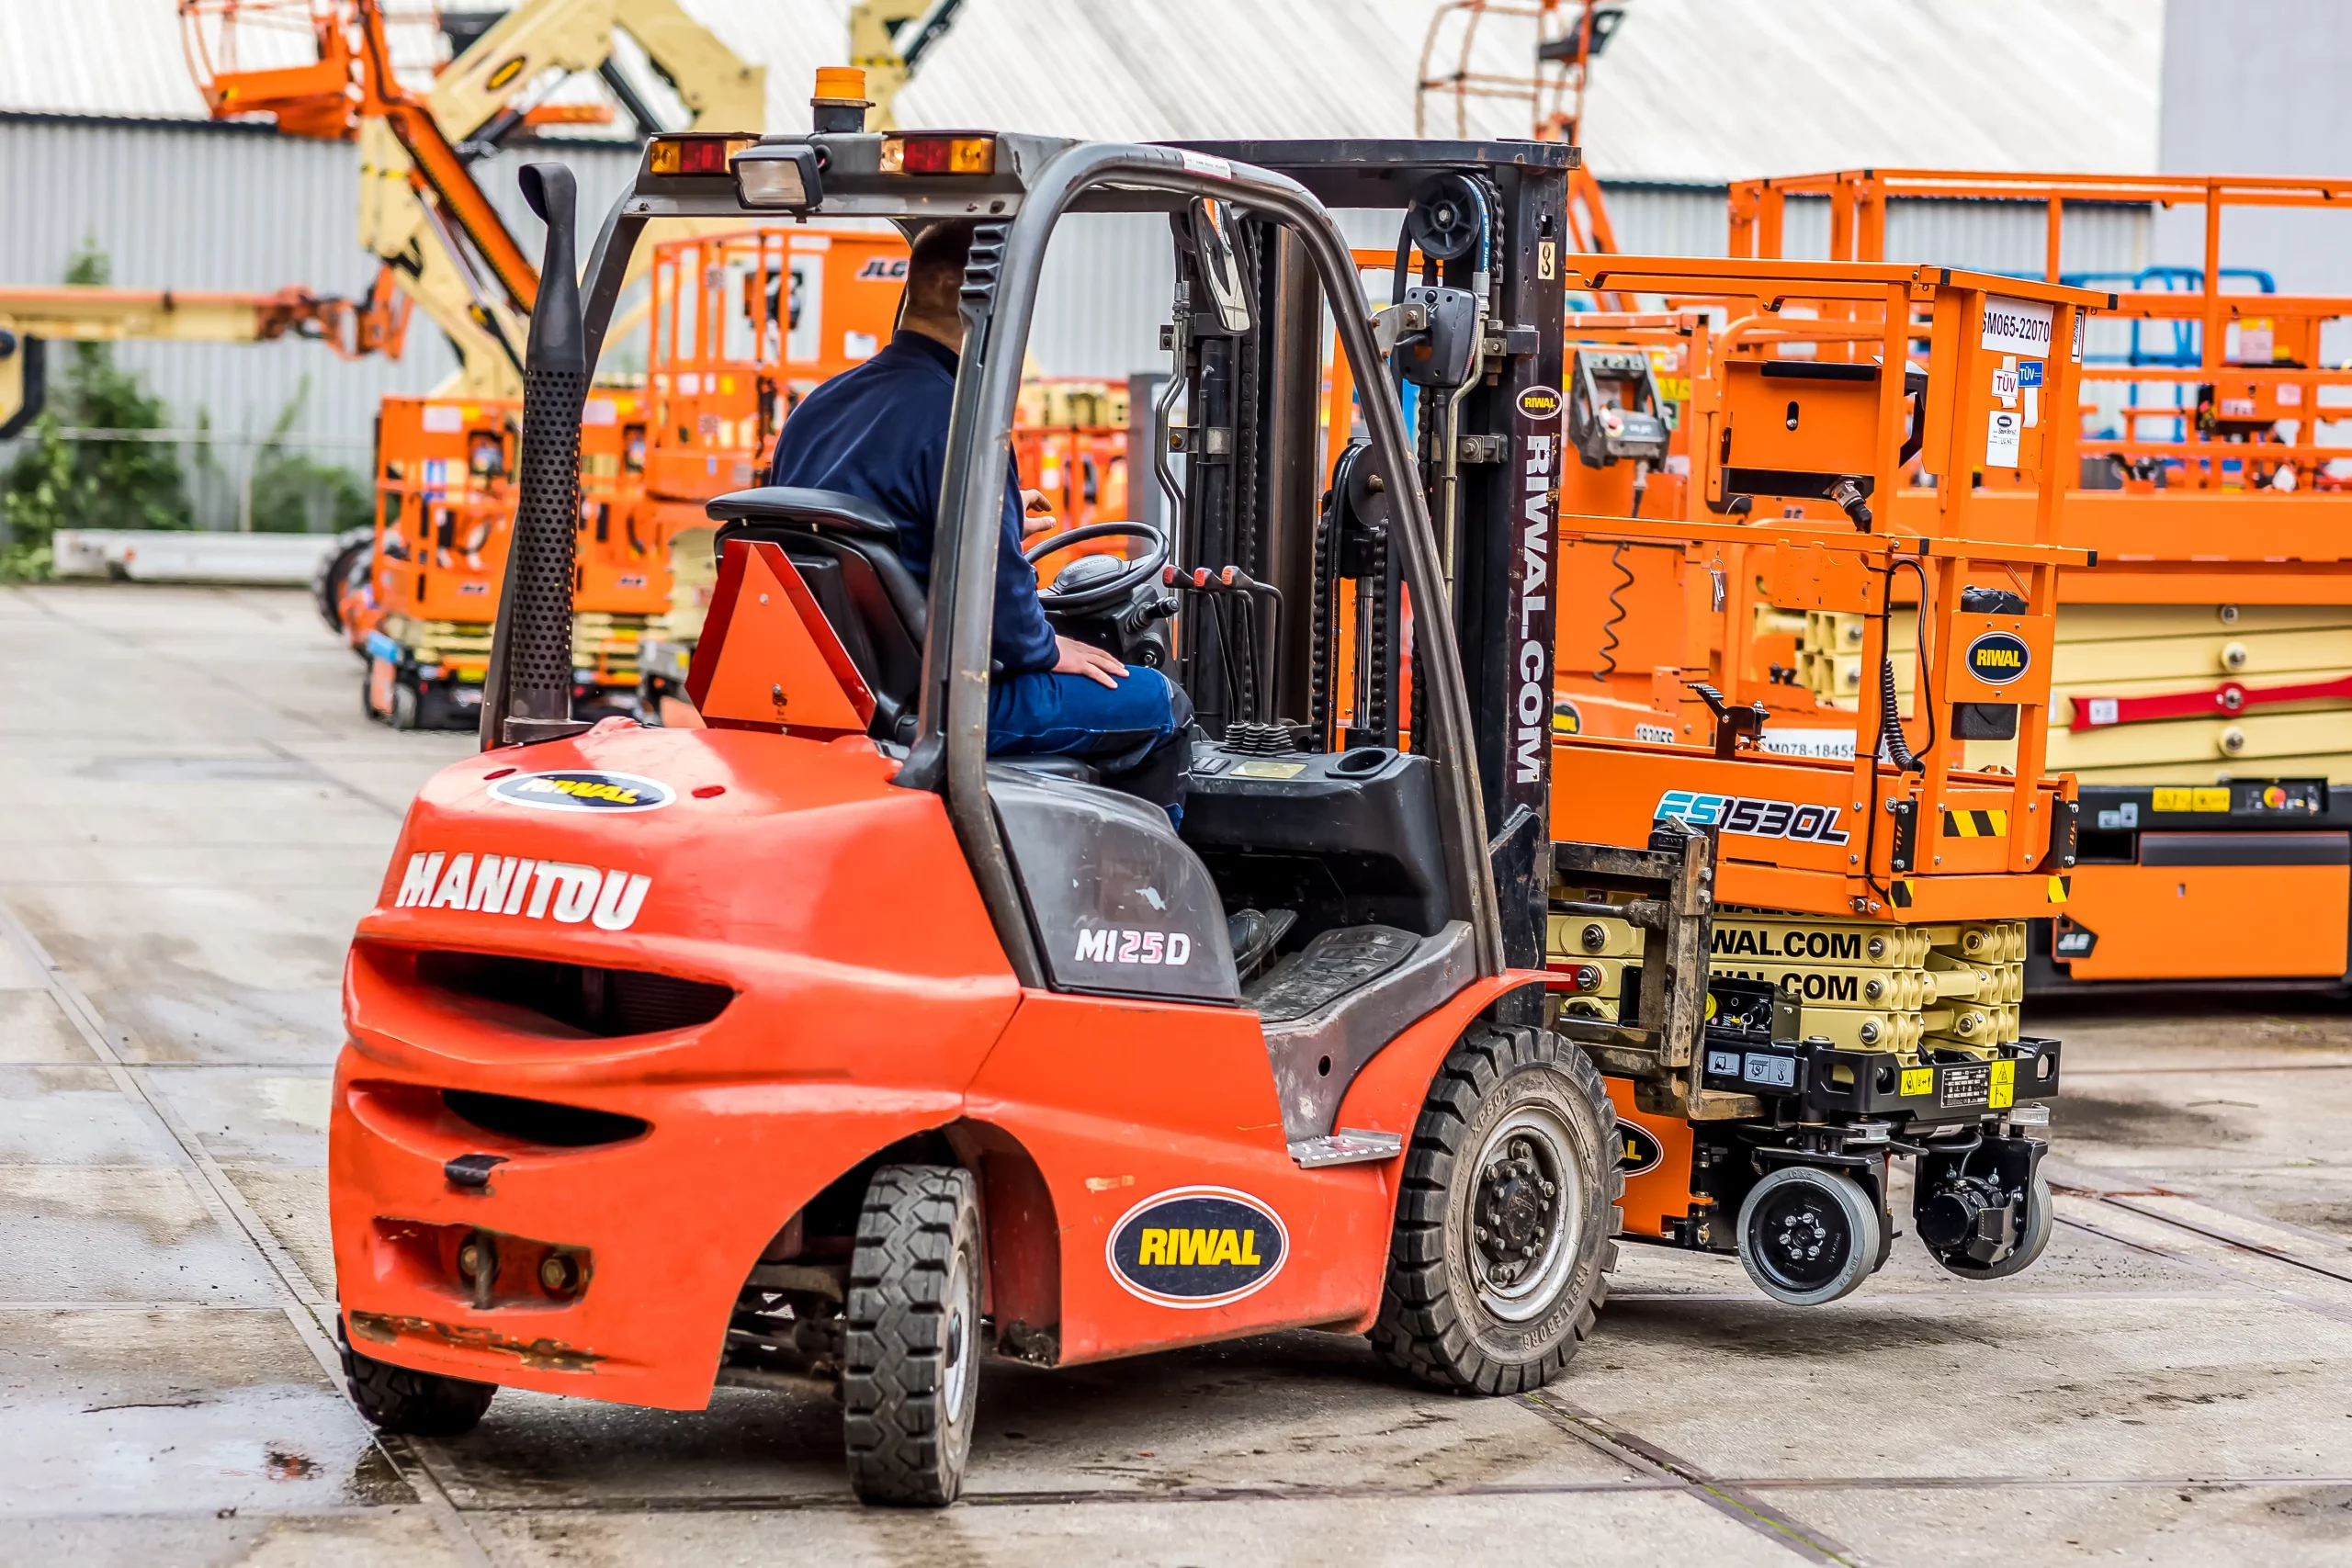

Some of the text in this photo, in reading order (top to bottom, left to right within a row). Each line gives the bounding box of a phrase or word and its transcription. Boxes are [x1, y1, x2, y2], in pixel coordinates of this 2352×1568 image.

[1996, 373, 2017, 393] TÜV
[2019, 367, 2035, 380] TÜV
[1524, 397, 1556, 409] RIWAL
[1515, 434, 1551, 784] RIWAL.COM
[1976, 649, 2021, 668] RIWAL
[1761, 742, 1855, 759] M078-18455
[516, 779, 641, 804] RIWAL
[1657, 793, 1848, 843] ES1530L
[394, 852, 652, 931] MANITOU
[1138, 1228, 1261, 1266] RIWAL
[1521, 1261, 1591, 1353] TRELLEBORG
